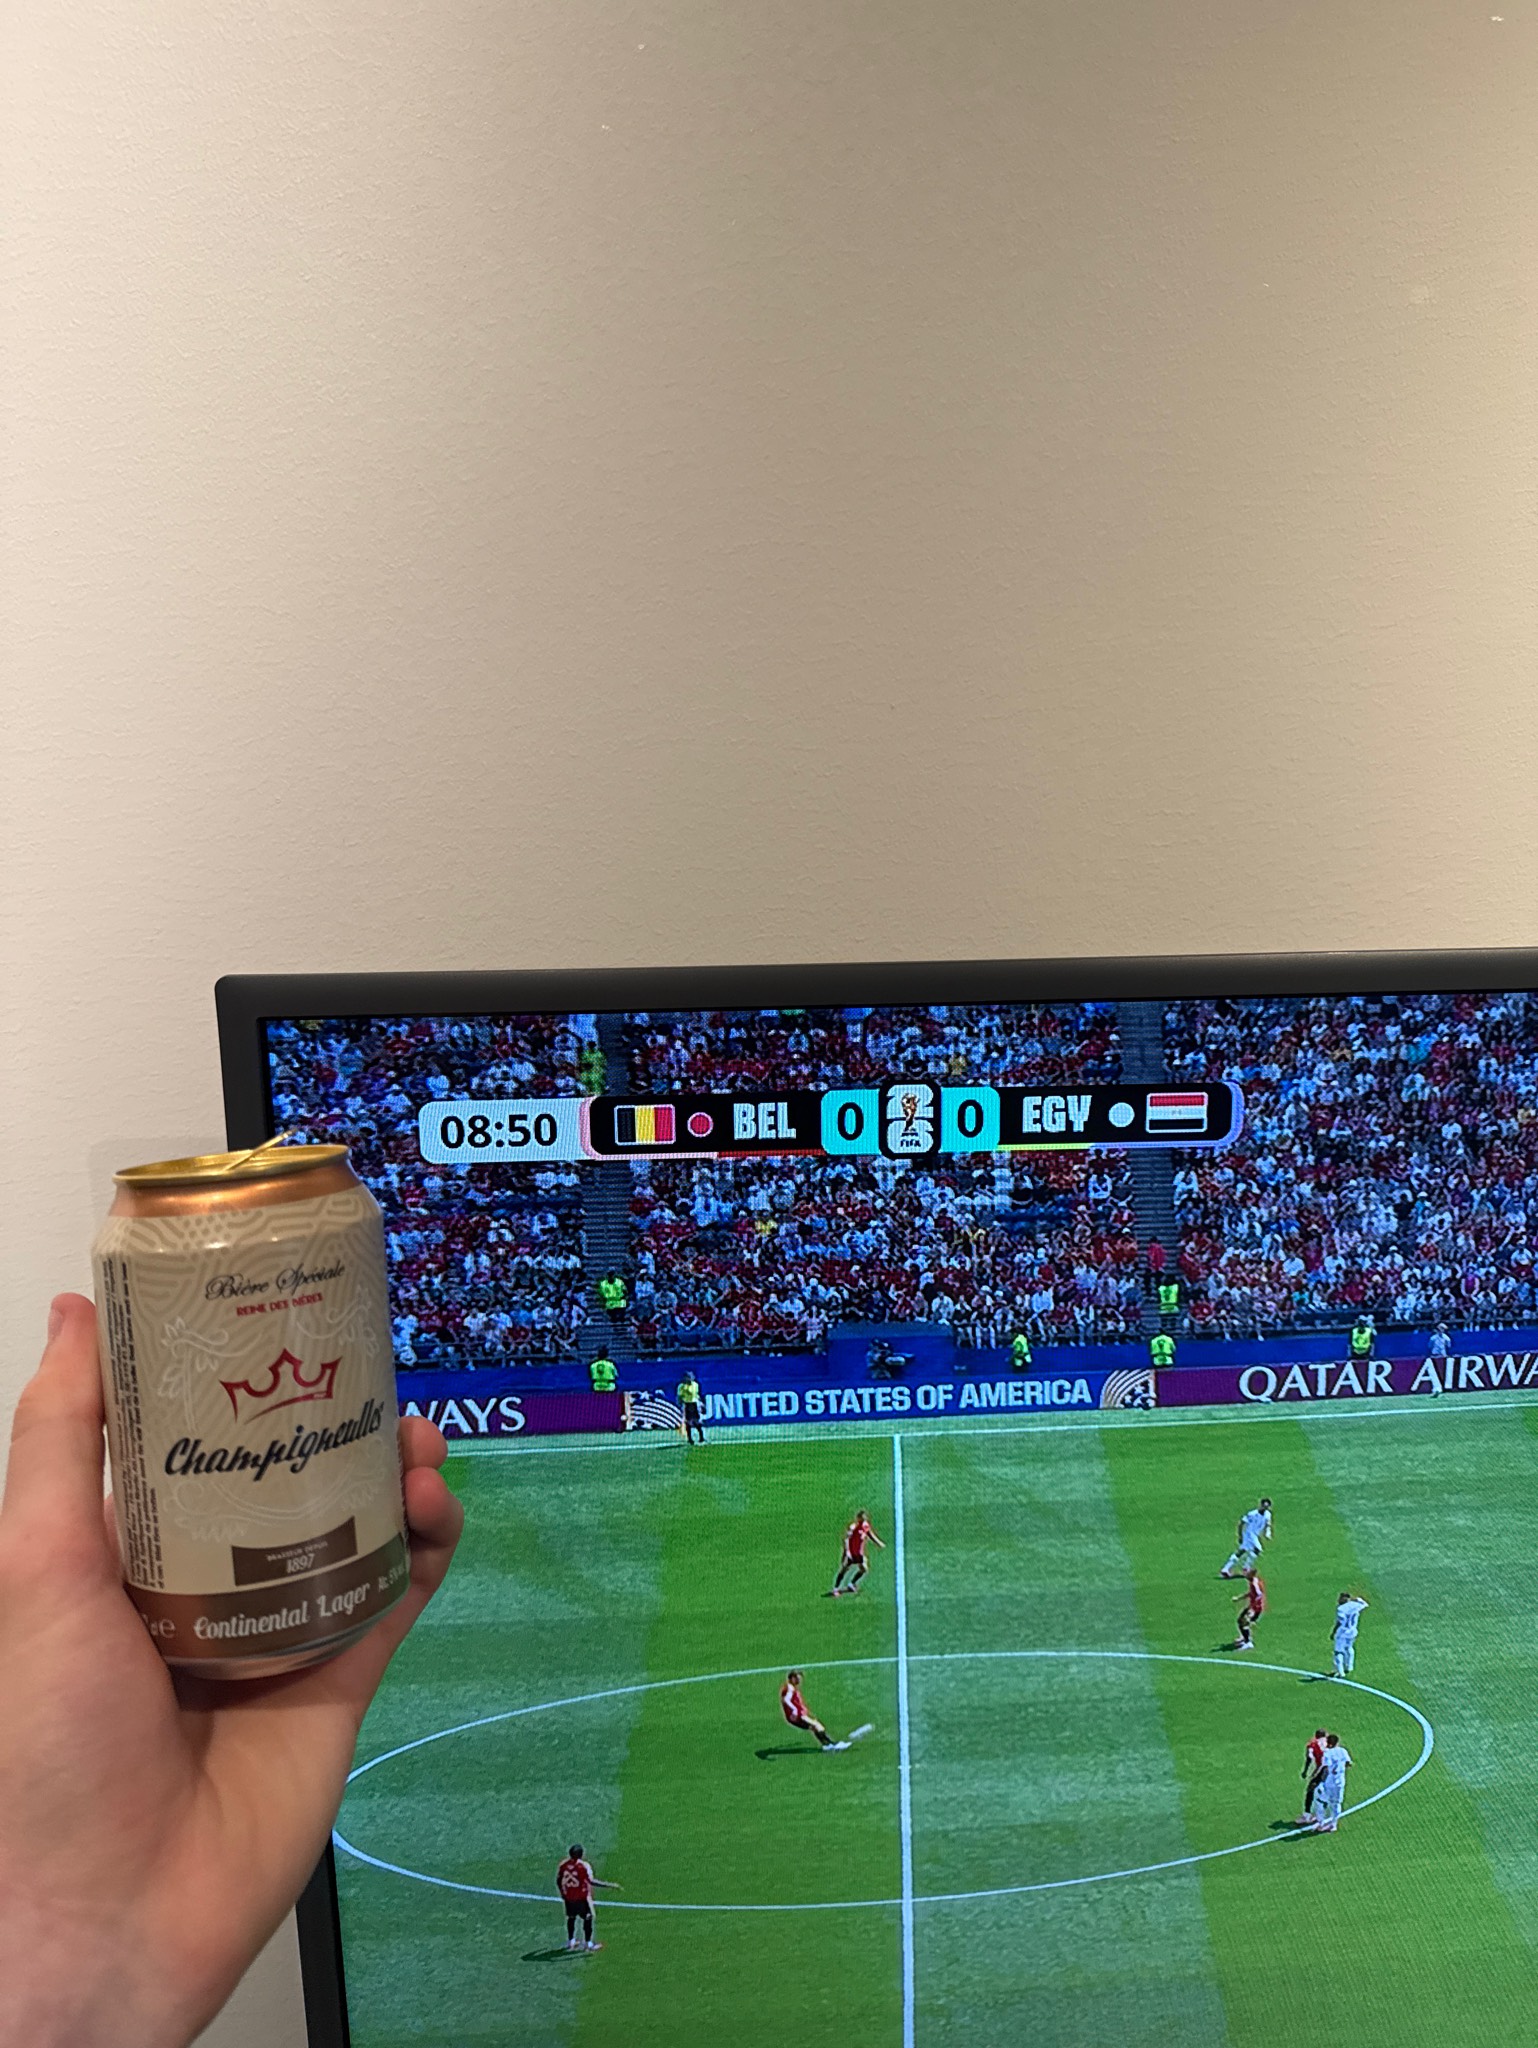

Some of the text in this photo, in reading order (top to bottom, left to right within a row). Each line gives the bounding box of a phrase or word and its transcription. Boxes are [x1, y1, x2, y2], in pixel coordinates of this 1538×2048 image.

[440, 1112, 558, 1149] 08:50
[733, 1101, 864, 1140] BEL 0
[957, 1095, 1092, 1138] 0 EGY
[205, 1273, 269, 1300] Bière
[805, 1386, 911, 1415] STATES
[916, 1384, 953, 1410] OF
[959, 1378, 1092, 1408] AMERICA
[1239, 1360, 1394, 1402] QATAR
[164, 1398, 385, 1482] Champigneulles
[286, 1552, 315, 1574] 1897
[193, 1606, 308, 1640] Continental
[317, 1582, 371, 1618] Lager
